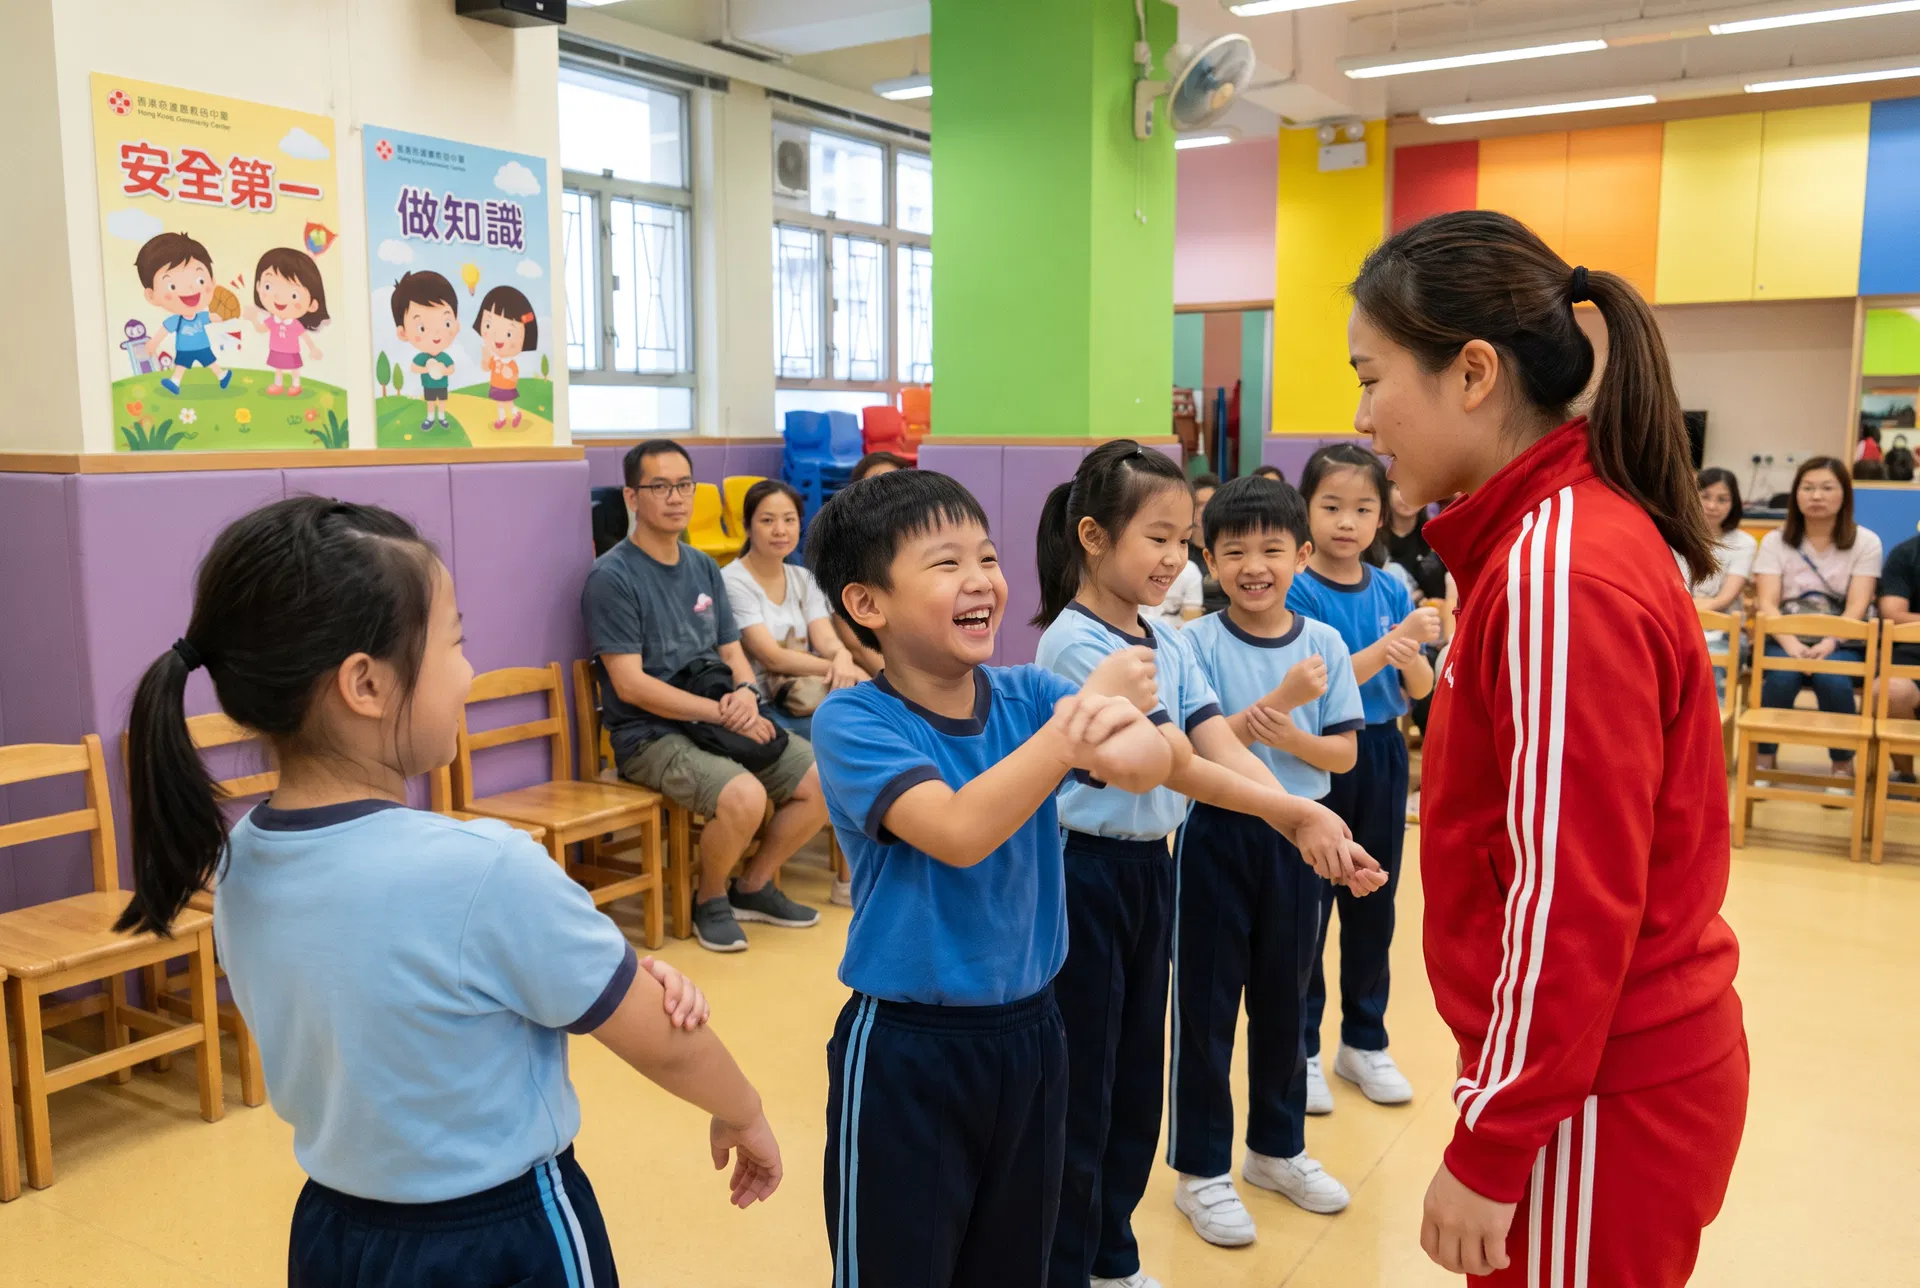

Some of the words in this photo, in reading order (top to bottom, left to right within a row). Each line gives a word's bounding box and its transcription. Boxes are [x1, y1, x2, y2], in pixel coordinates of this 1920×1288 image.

[121, 142, 320, 209] 安全第一
[398, 188, 523, 250] 做知識
